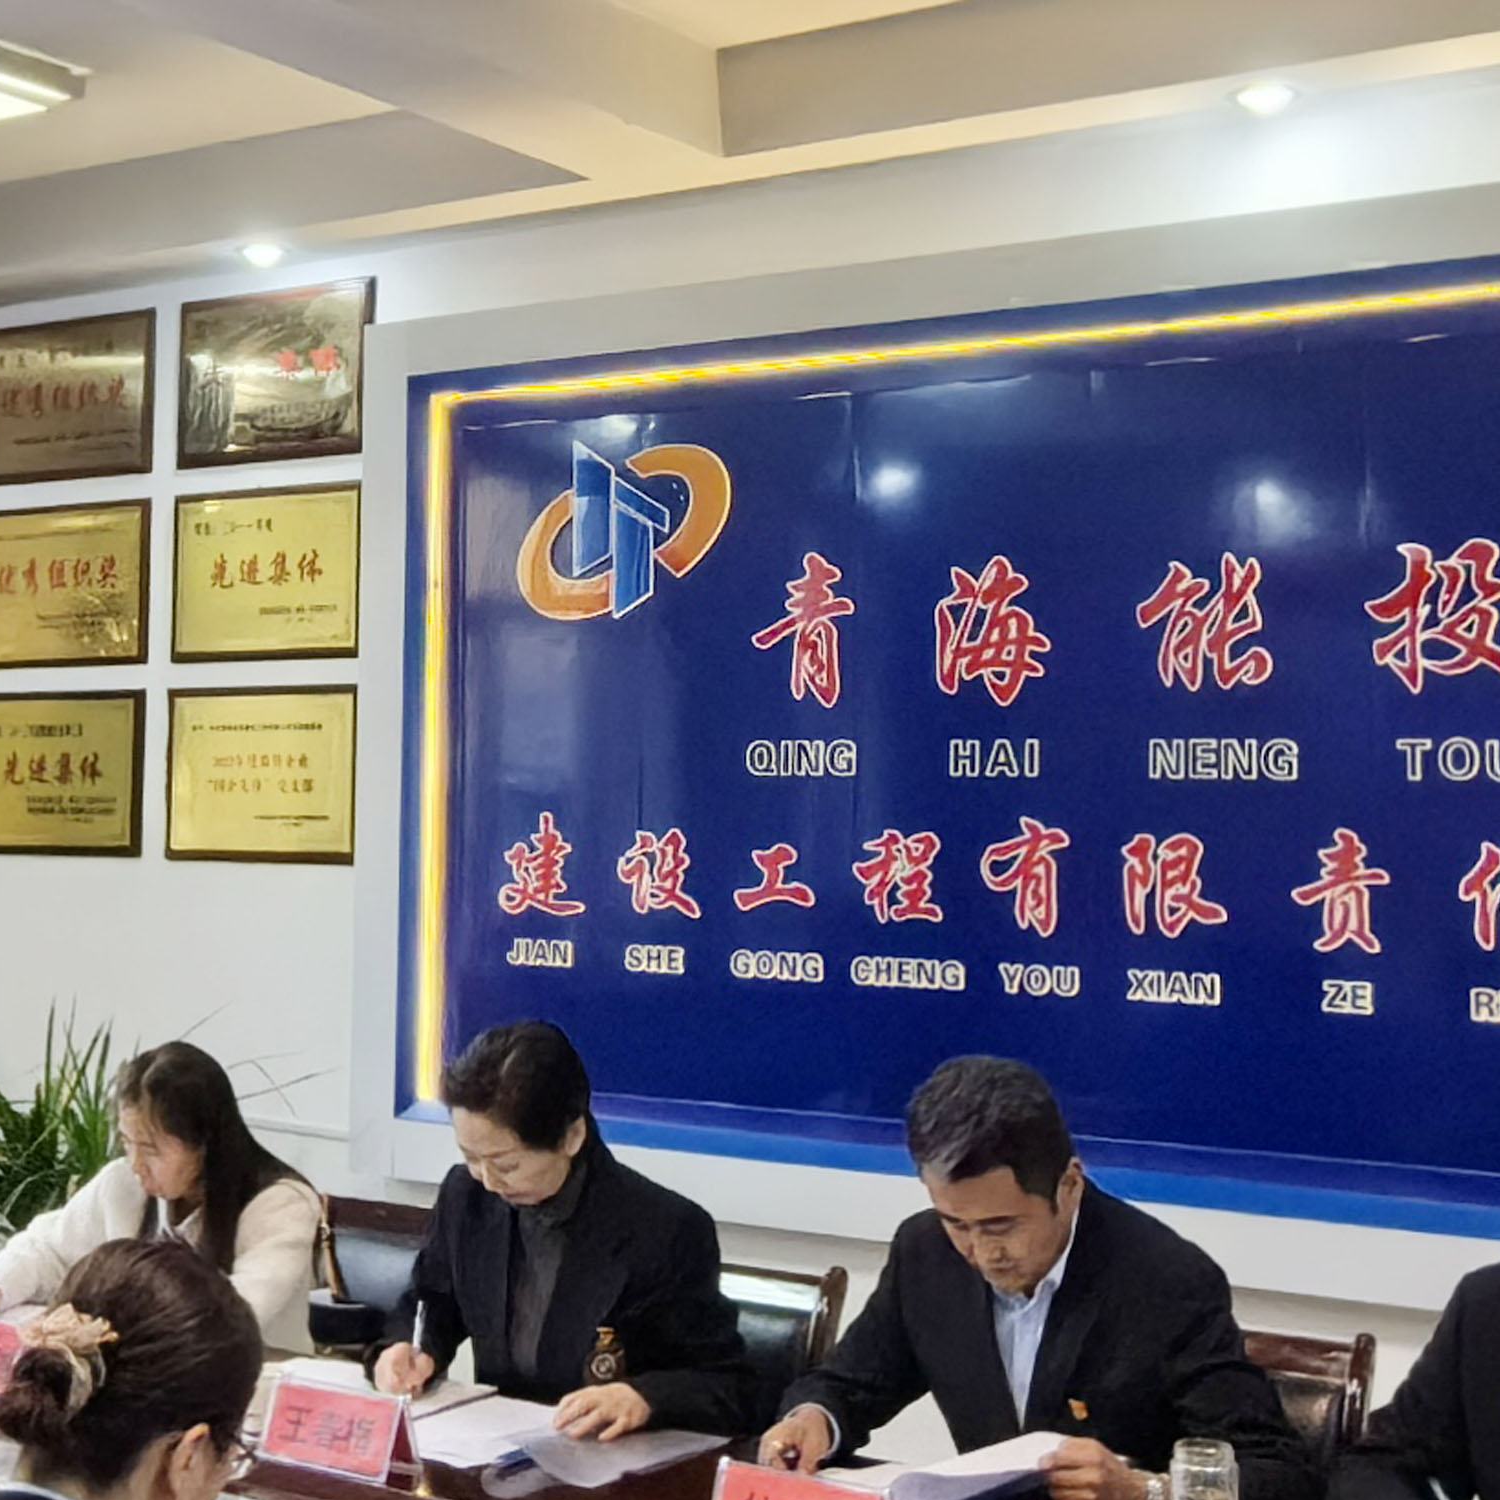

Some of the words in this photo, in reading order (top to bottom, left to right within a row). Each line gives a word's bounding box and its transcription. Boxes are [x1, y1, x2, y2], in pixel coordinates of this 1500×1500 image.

[210, 548, 323, 589] 先进集体
[3, 750, 104, 786] 先进集体
[746, 739, 858, 777] QING
[948, 739, 1040, 778] HAI
[1148, 738, 1300, 781] NENG
[506, 939, 573, 969] JIAN
[624, 945, 685, 974] SHE
[729, 950, 824, 982] GONG
[850, 955, 966, 990] CHENG
[998, 963, 1080, 997] YOU
[1127, 970, 1221, 1006] XIAN
[1321, 979, 1374, 1015] ZE
